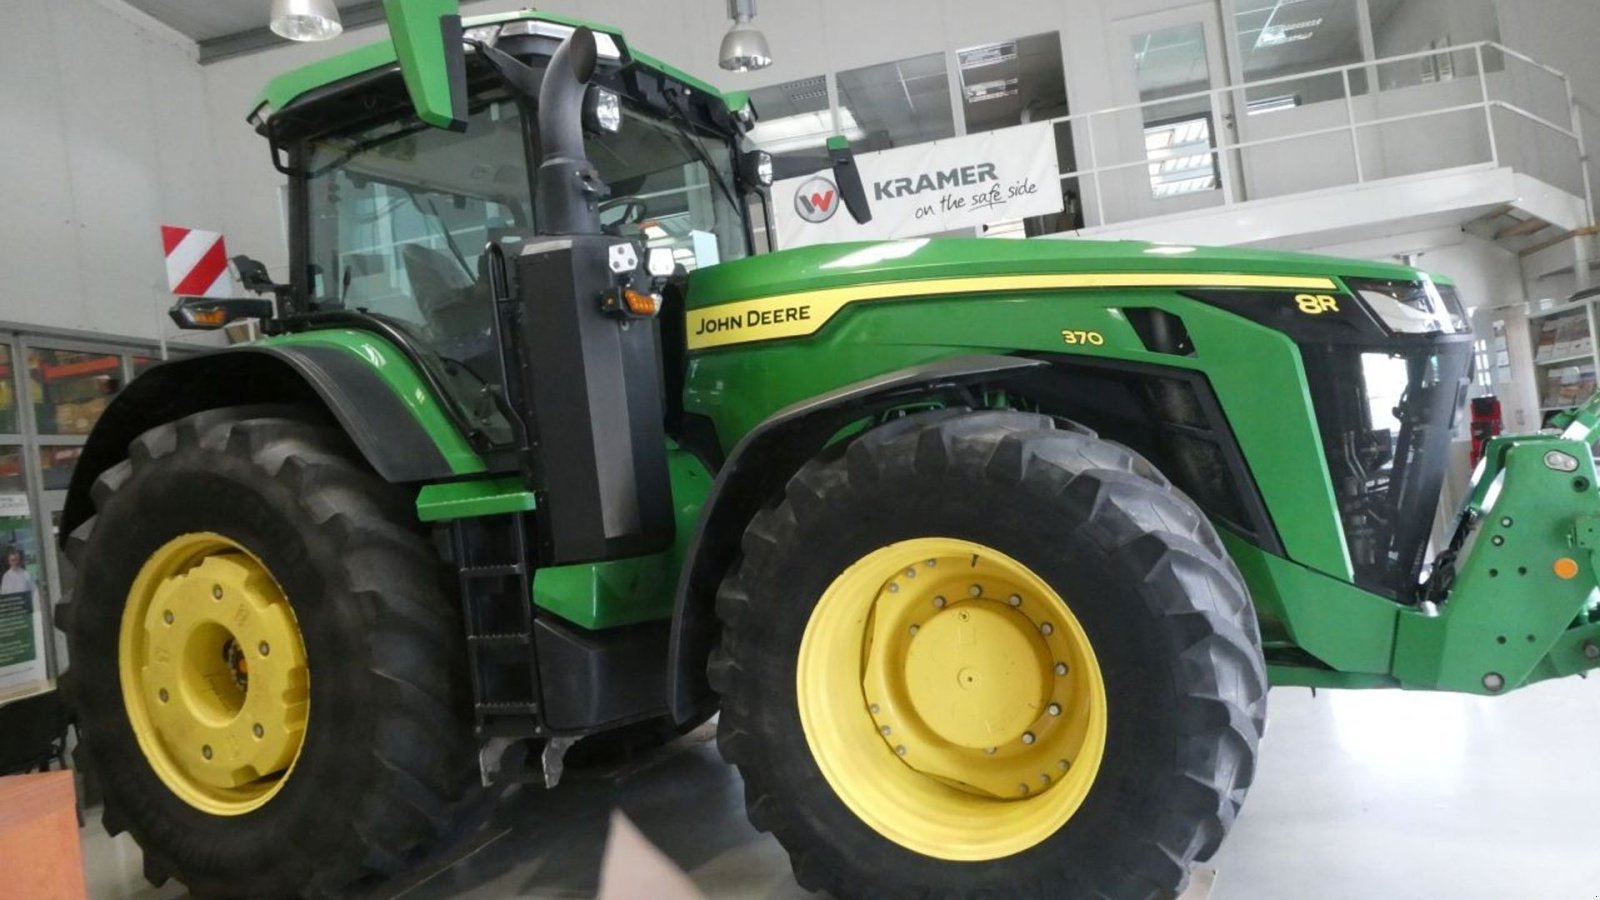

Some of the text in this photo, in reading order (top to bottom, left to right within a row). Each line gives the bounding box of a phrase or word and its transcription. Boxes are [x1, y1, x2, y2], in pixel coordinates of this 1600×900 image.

[874, 162, 998, 200] KRAMER
[915, 176, 1038, 219] on the safe side
[1294, 293, 1340, 315] 8R
[696, 305, 811, 335] JOHN DEERE
[1061, 330, 1104, 346] 370
